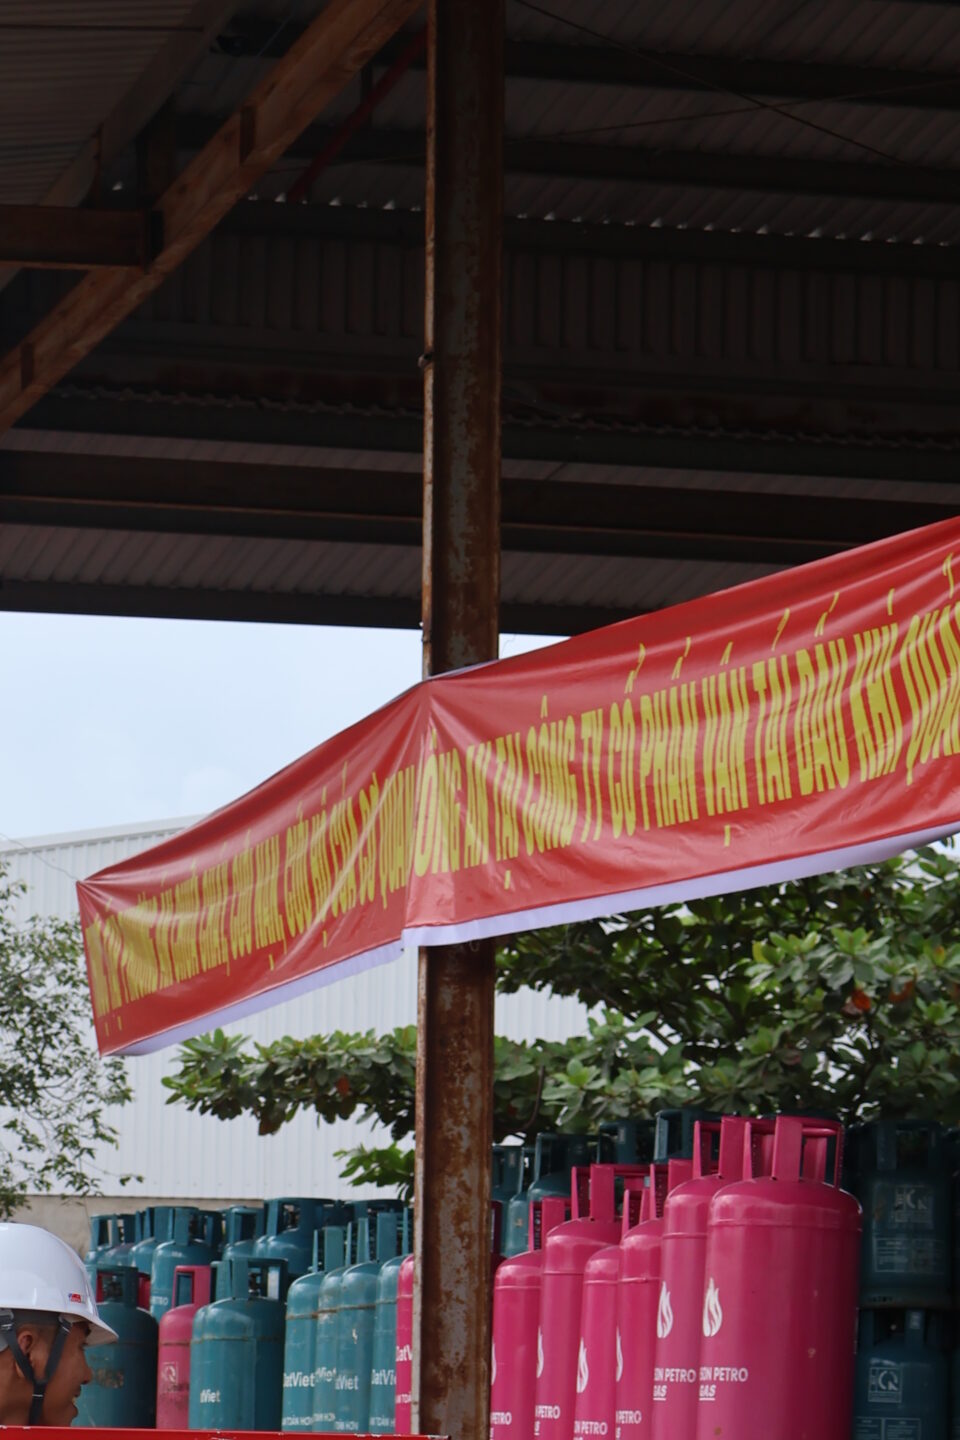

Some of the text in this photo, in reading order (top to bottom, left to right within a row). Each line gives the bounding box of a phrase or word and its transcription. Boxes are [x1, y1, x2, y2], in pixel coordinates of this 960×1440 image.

[284, 800, 313, 939] CỨU
[310, 785, 332, 948] HỘ
[329, 761, 358, 919] CỦA
[358, 771, 380, 906] CƠ
[380, 764, 416, 910] QUAN
[413, 727, 462, 877] ÔNG
[463, 741, 491, 869] AN
[493, 732, 523, 890] TẠI
[522, 694, 578, 857] CÔNG
[580, 708, 603, 843] TY
[607, 643, 646, 840] CỔ
[639, 636, 700, 832] PHẦN
[702, 641, 750, 847] VẬN
[752, 608, 793, 805] TẢI
[794, 591, 850, 796] DẦU
[849, 588, 904, 783] KHÍ
[664, 1367, 697, 1384] PETRO
[713, 1367, 749, 1383] PETRO
[581, 1420, 609, 1436] PETRO
